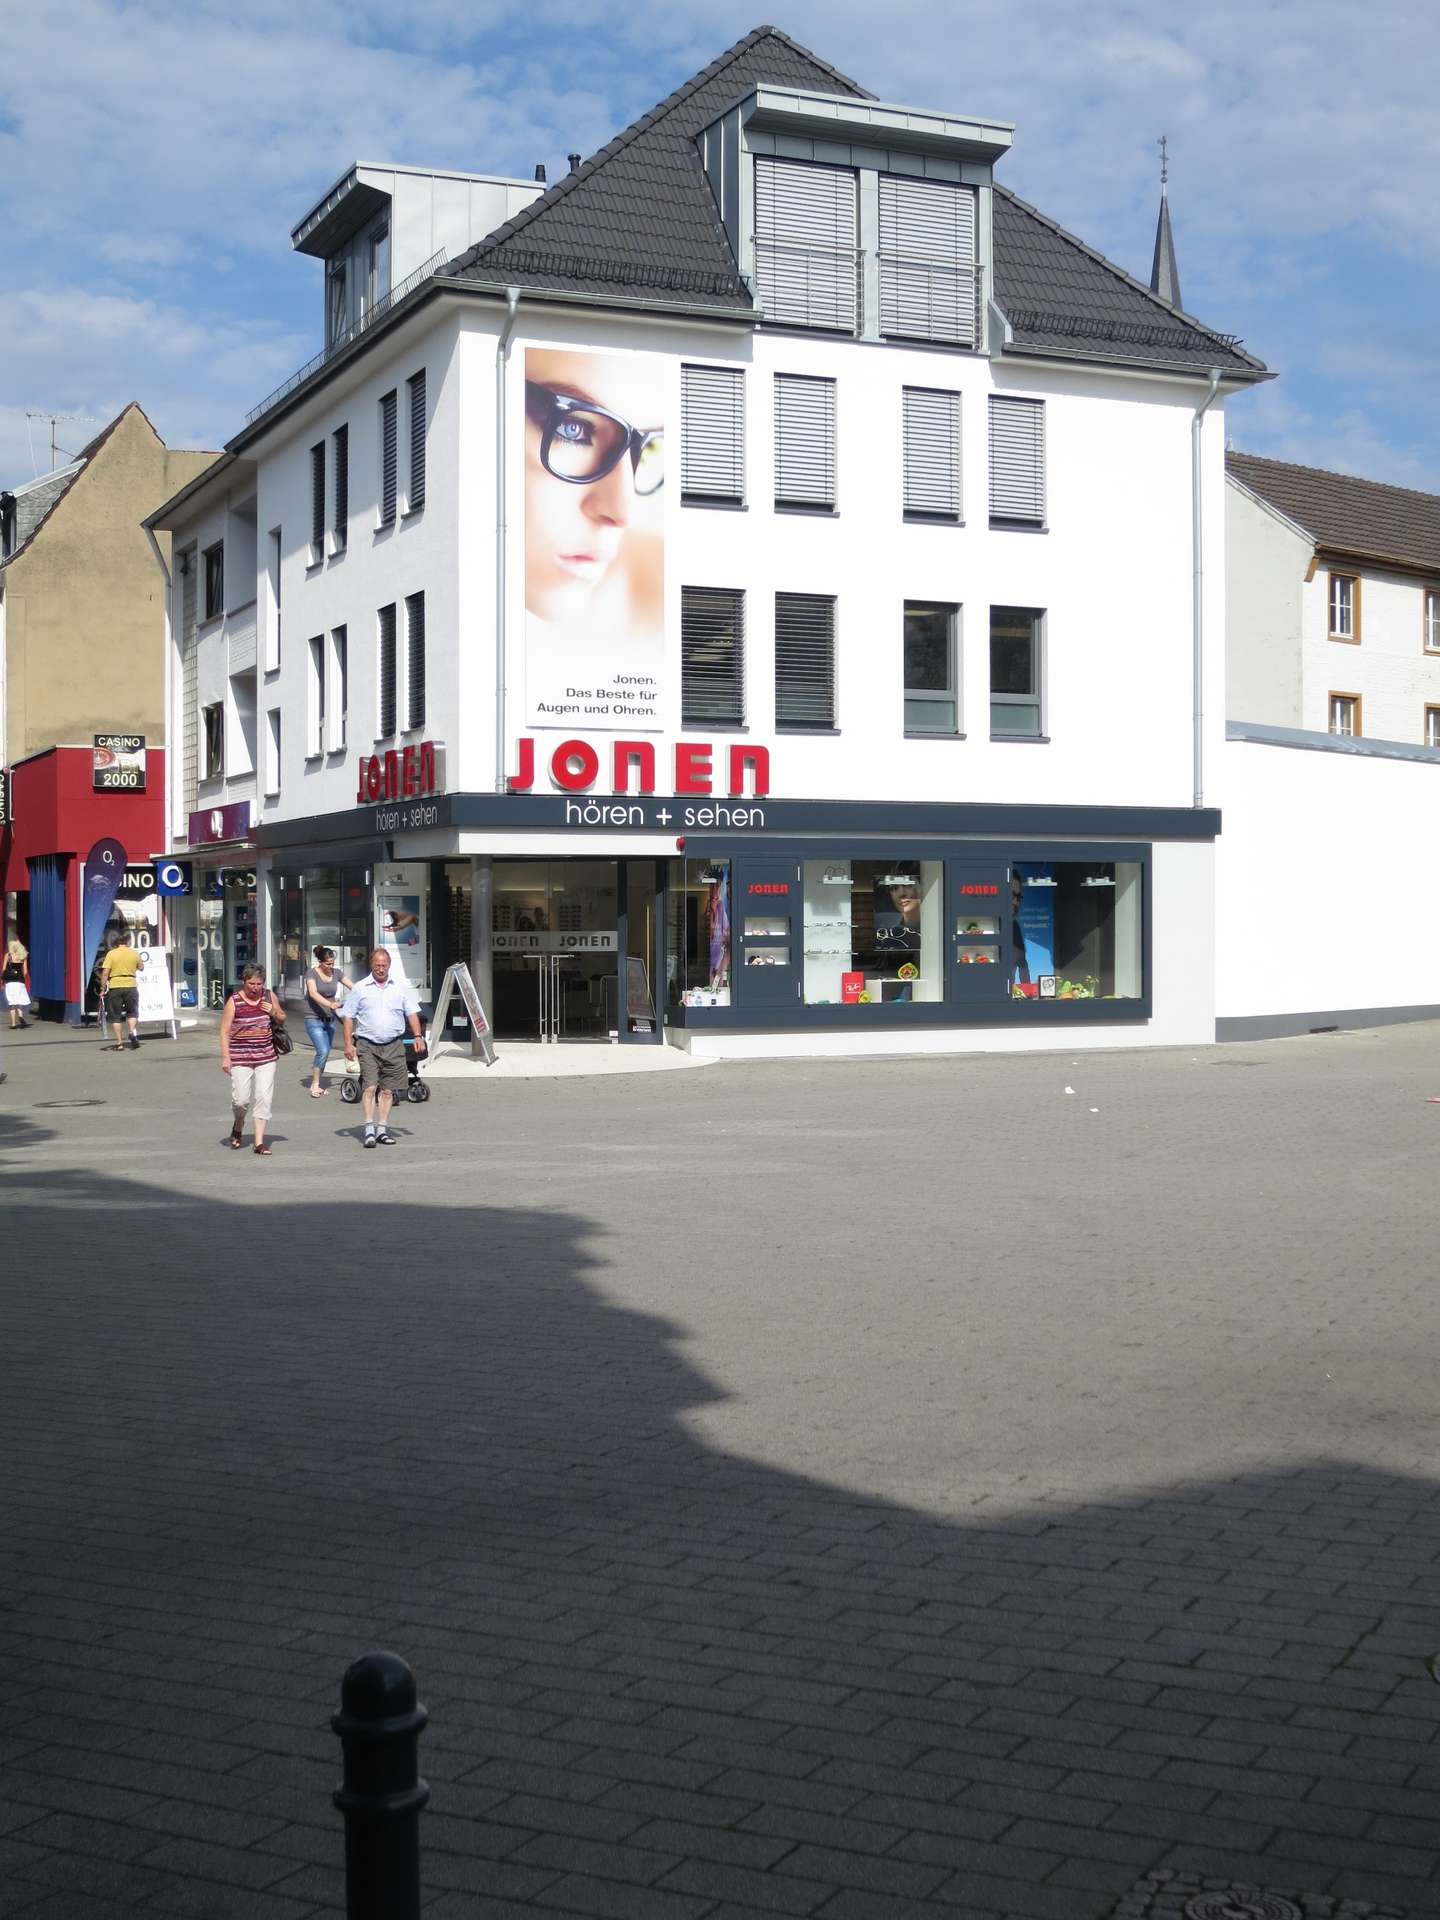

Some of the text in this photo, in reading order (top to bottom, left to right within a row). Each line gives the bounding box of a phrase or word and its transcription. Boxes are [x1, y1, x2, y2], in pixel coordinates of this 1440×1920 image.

[613, 674, 657, 686] Jonen.
[566, 687, 658, 701] Das Beste für
[537, 702, 657, 716] Augen und Ohren.
[98, 737, 140, 747] CASINO
[103, 773, 137, 786] 2000
[376, 804, 438, 832] hören + sehen
[566, 800, 765, 827] hören + sehen
[161, 864, 190, 892] O2
